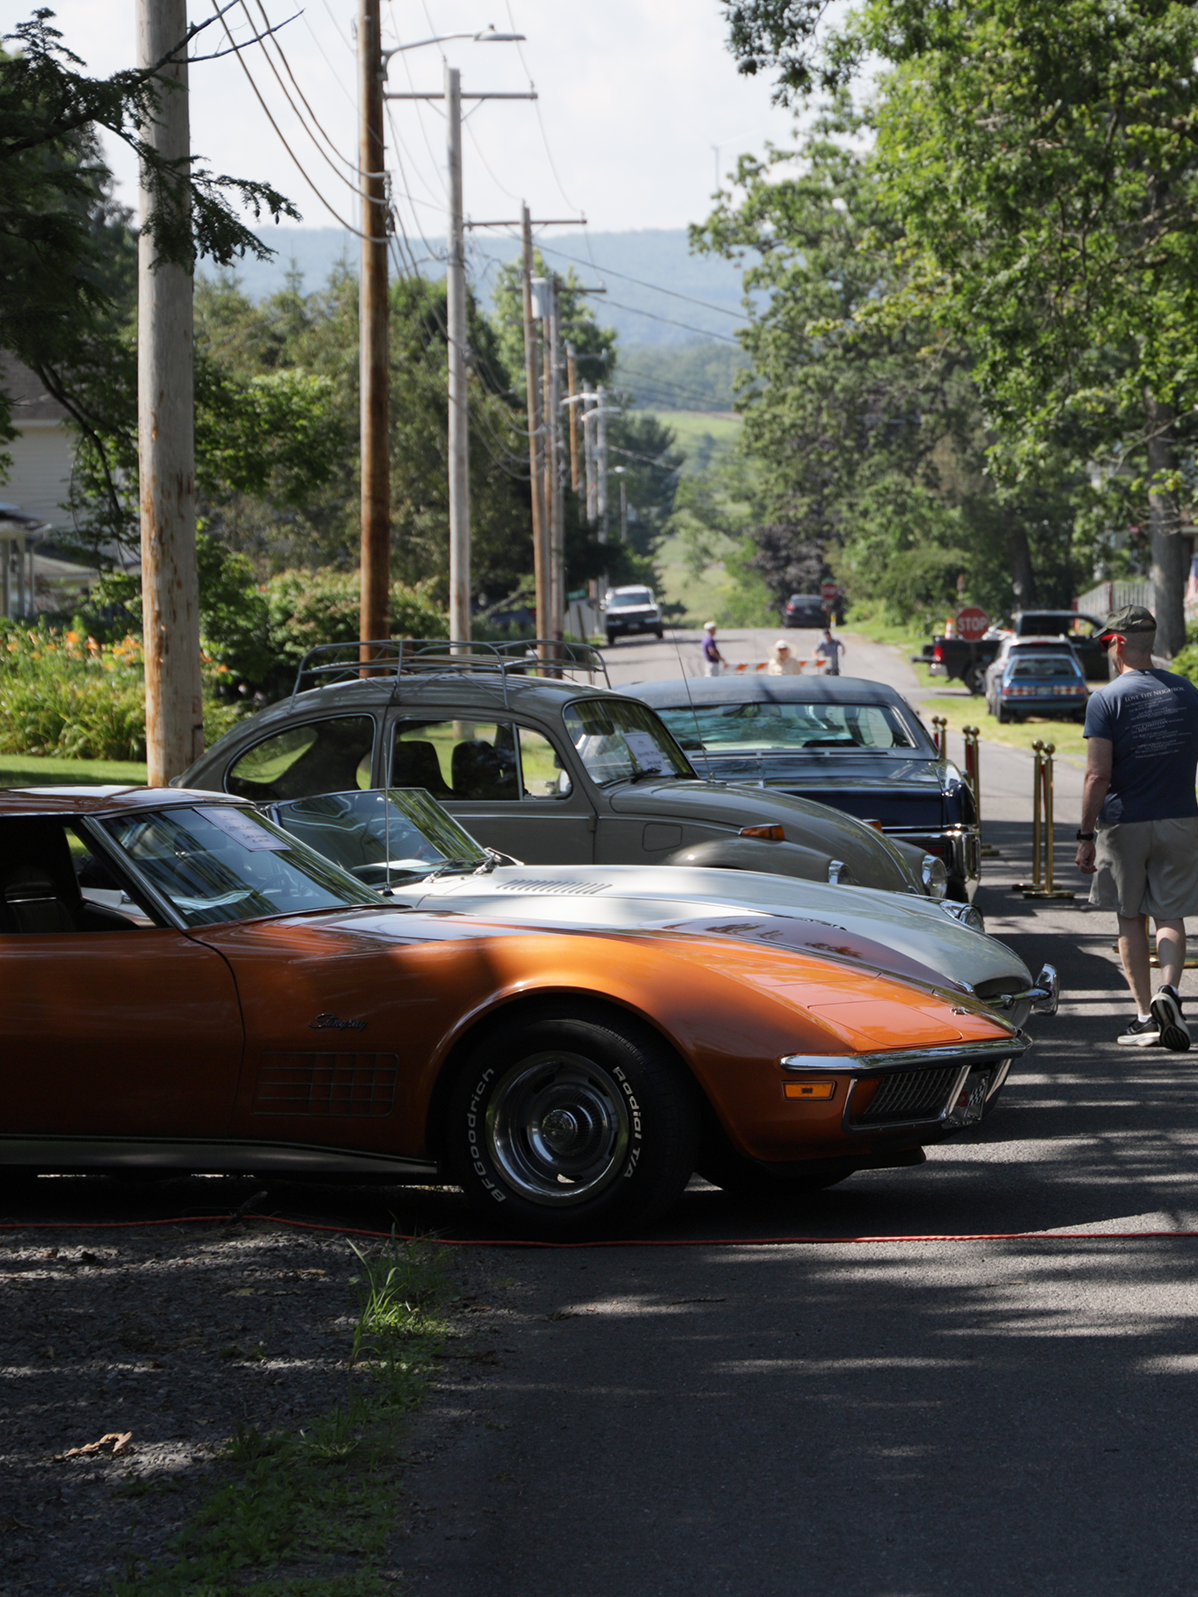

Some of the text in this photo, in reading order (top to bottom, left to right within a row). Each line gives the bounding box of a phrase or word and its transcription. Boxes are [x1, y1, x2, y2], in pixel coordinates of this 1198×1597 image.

[957, 617, 988, 632] STOP
[308, 1012, 369, 1032] Stingray
[467, 1068, 506, 1202] BFGoodrich
[612, 1066, 642, 1178] Radial T/A
